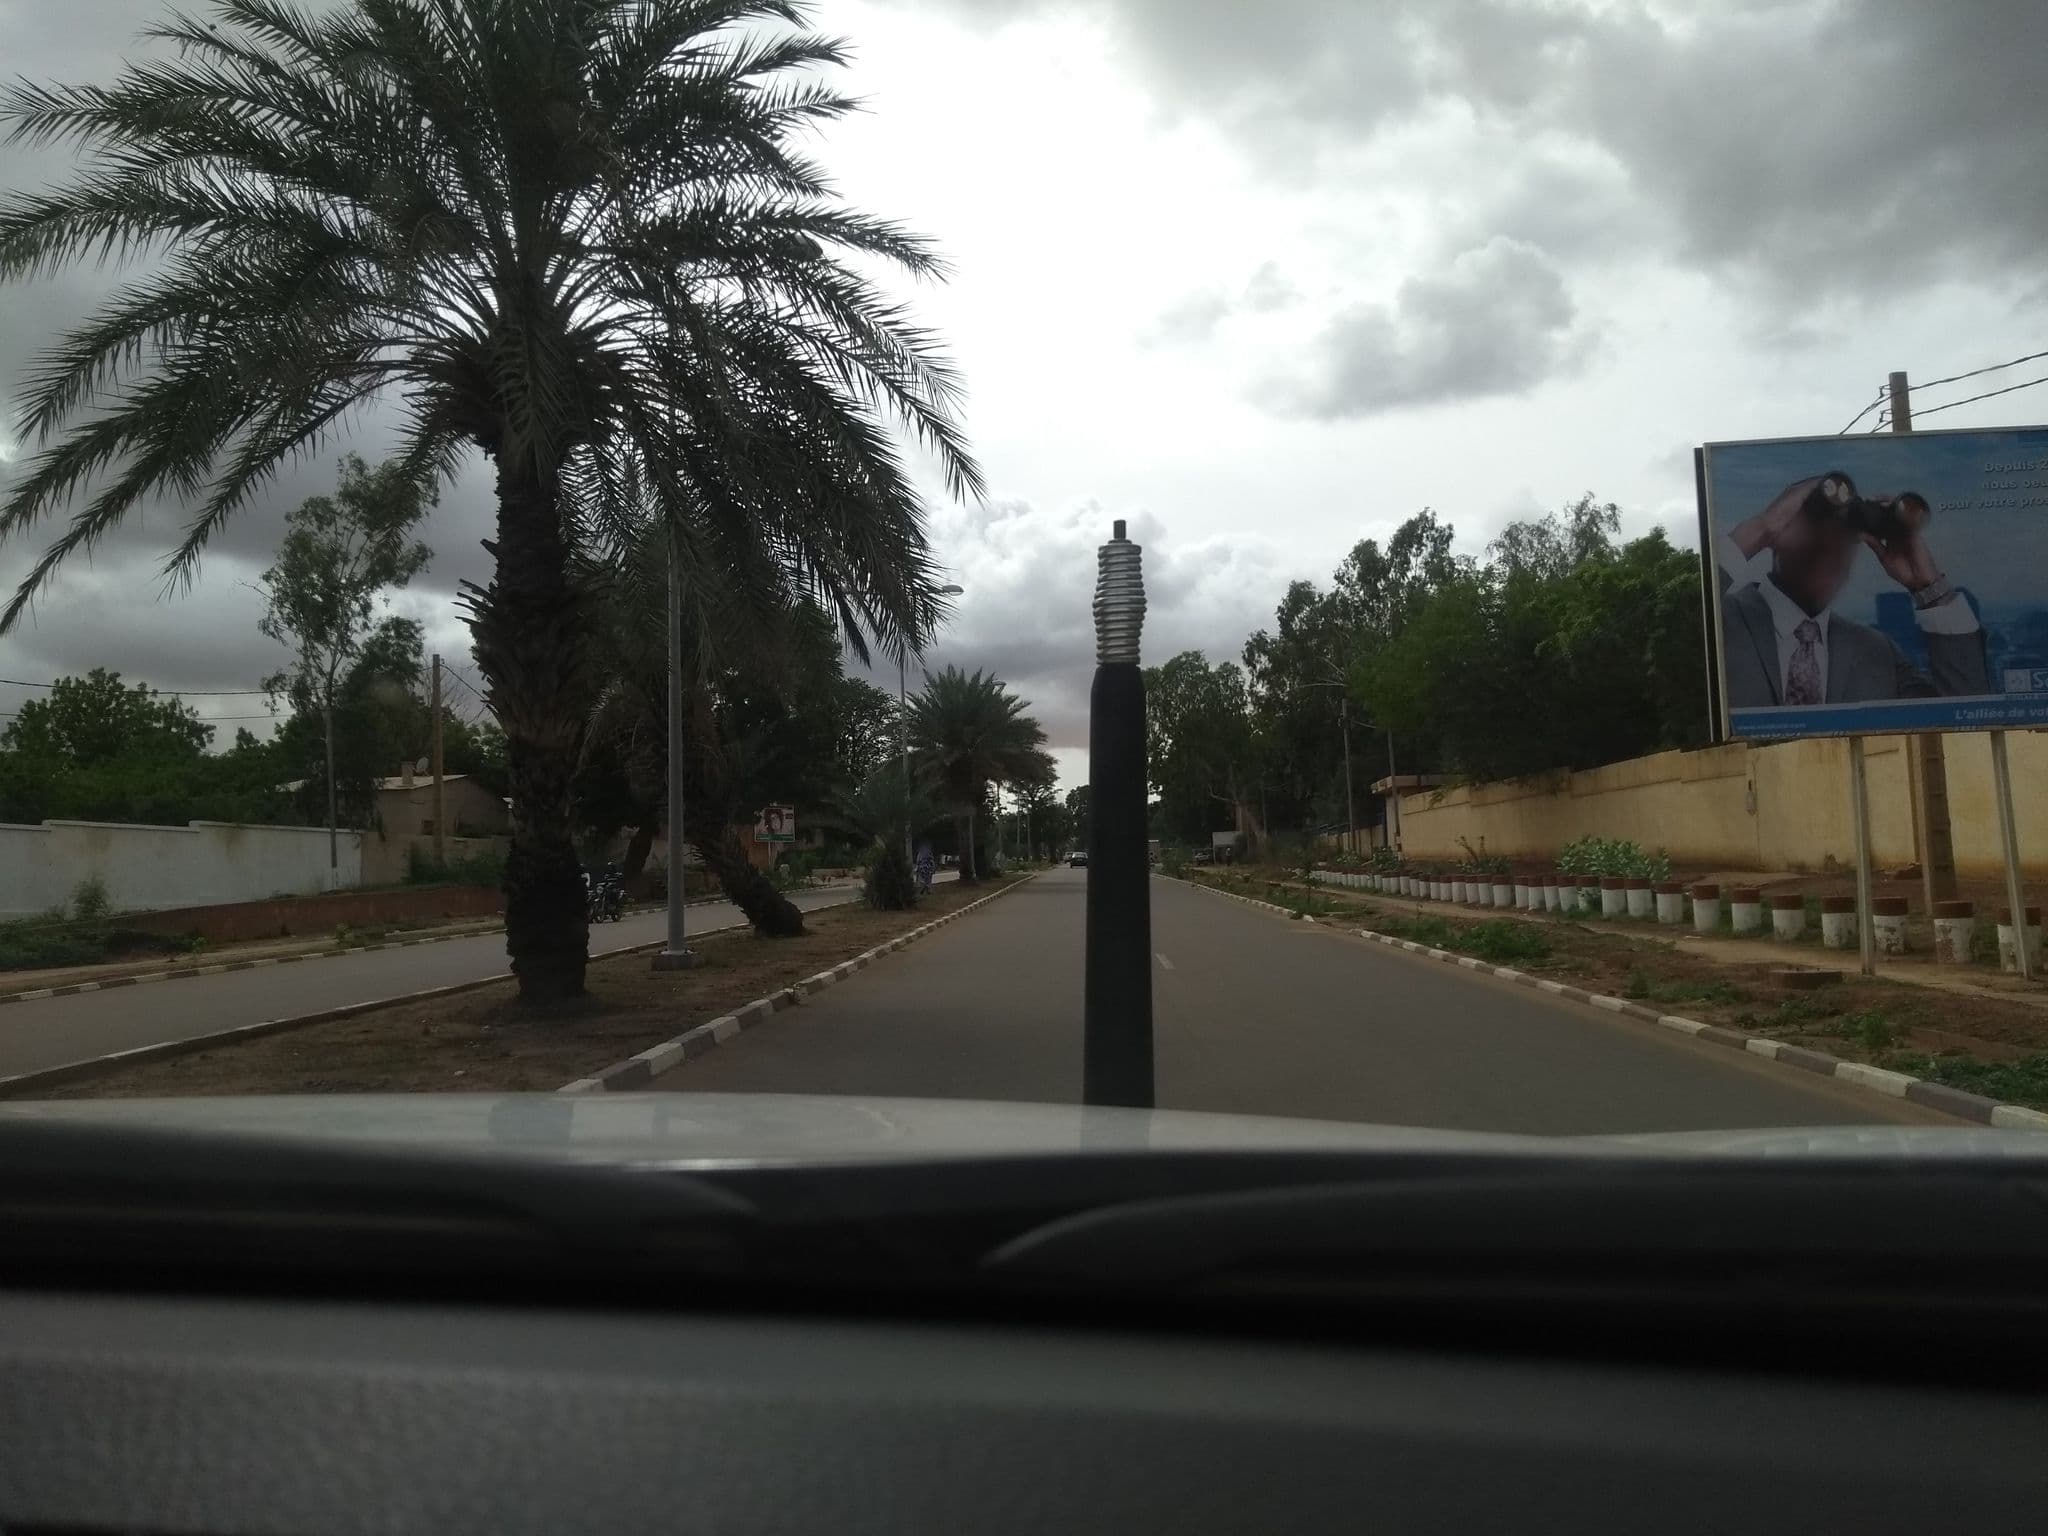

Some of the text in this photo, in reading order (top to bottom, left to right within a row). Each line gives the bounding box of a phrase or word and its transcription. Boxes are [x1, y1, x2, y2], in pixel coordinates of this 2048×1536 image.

[1984, 461, 2035, 473] Depuis
[1983, 479, 2017, 490] nous
[1938, 499, 1970, 512] pour
[2008, 706, 2025, 718] de
